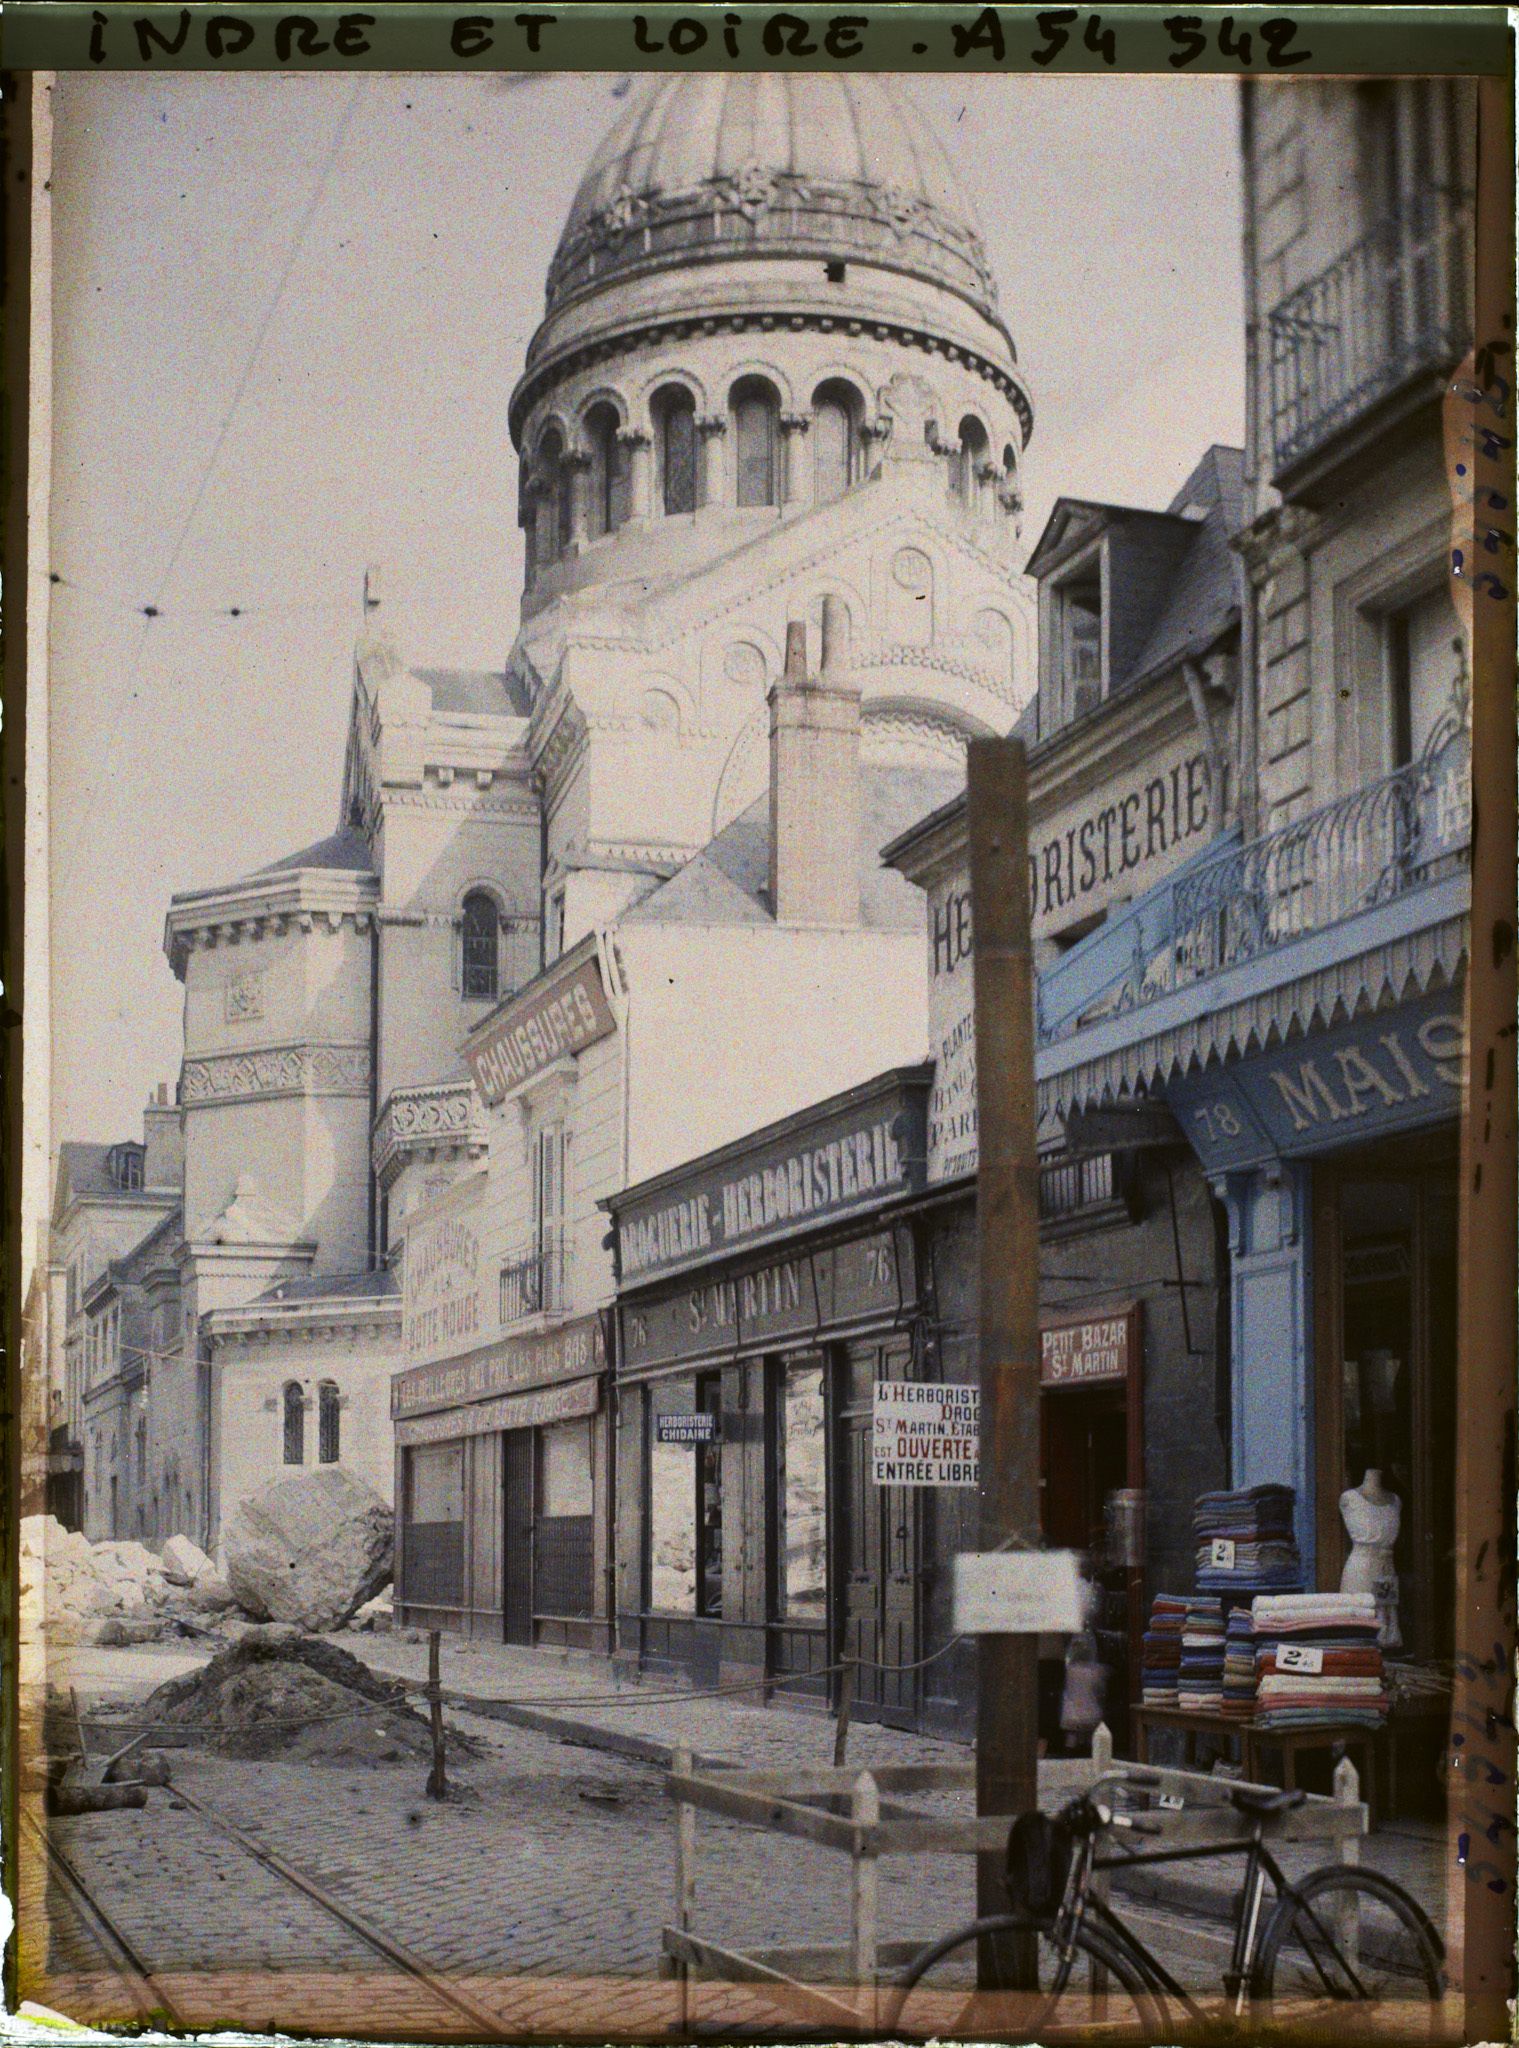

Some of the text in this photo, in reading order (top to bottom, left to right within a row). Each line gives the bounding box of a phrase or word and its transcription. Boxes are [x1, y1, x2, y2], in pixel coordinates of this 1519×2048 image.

[450, 16, 557, 58] ET
[1163, 15, 1312, 67] 542
[476, 982, 597, 1095] CHAUSSURES
[1196, 1103, 1240, 1142] 78
[868, 1246, 889, 1287] 76
[564, 1332, 588, 1370] BAS
[1042, 1320, 1126, 1358] PETIT BAZAR
[1071, 1348, 1119, 1377] MARTIN
[661, 1428, 711, 1440] CHIDAINE
[874, 1446, 892, 1458] EST
[897, 1437, 973, 1460] OUVERTE
[877, 1459, 981, 1481] ENTRÉE LIBRE
[1283, 1650, 1302, 1666] 2
